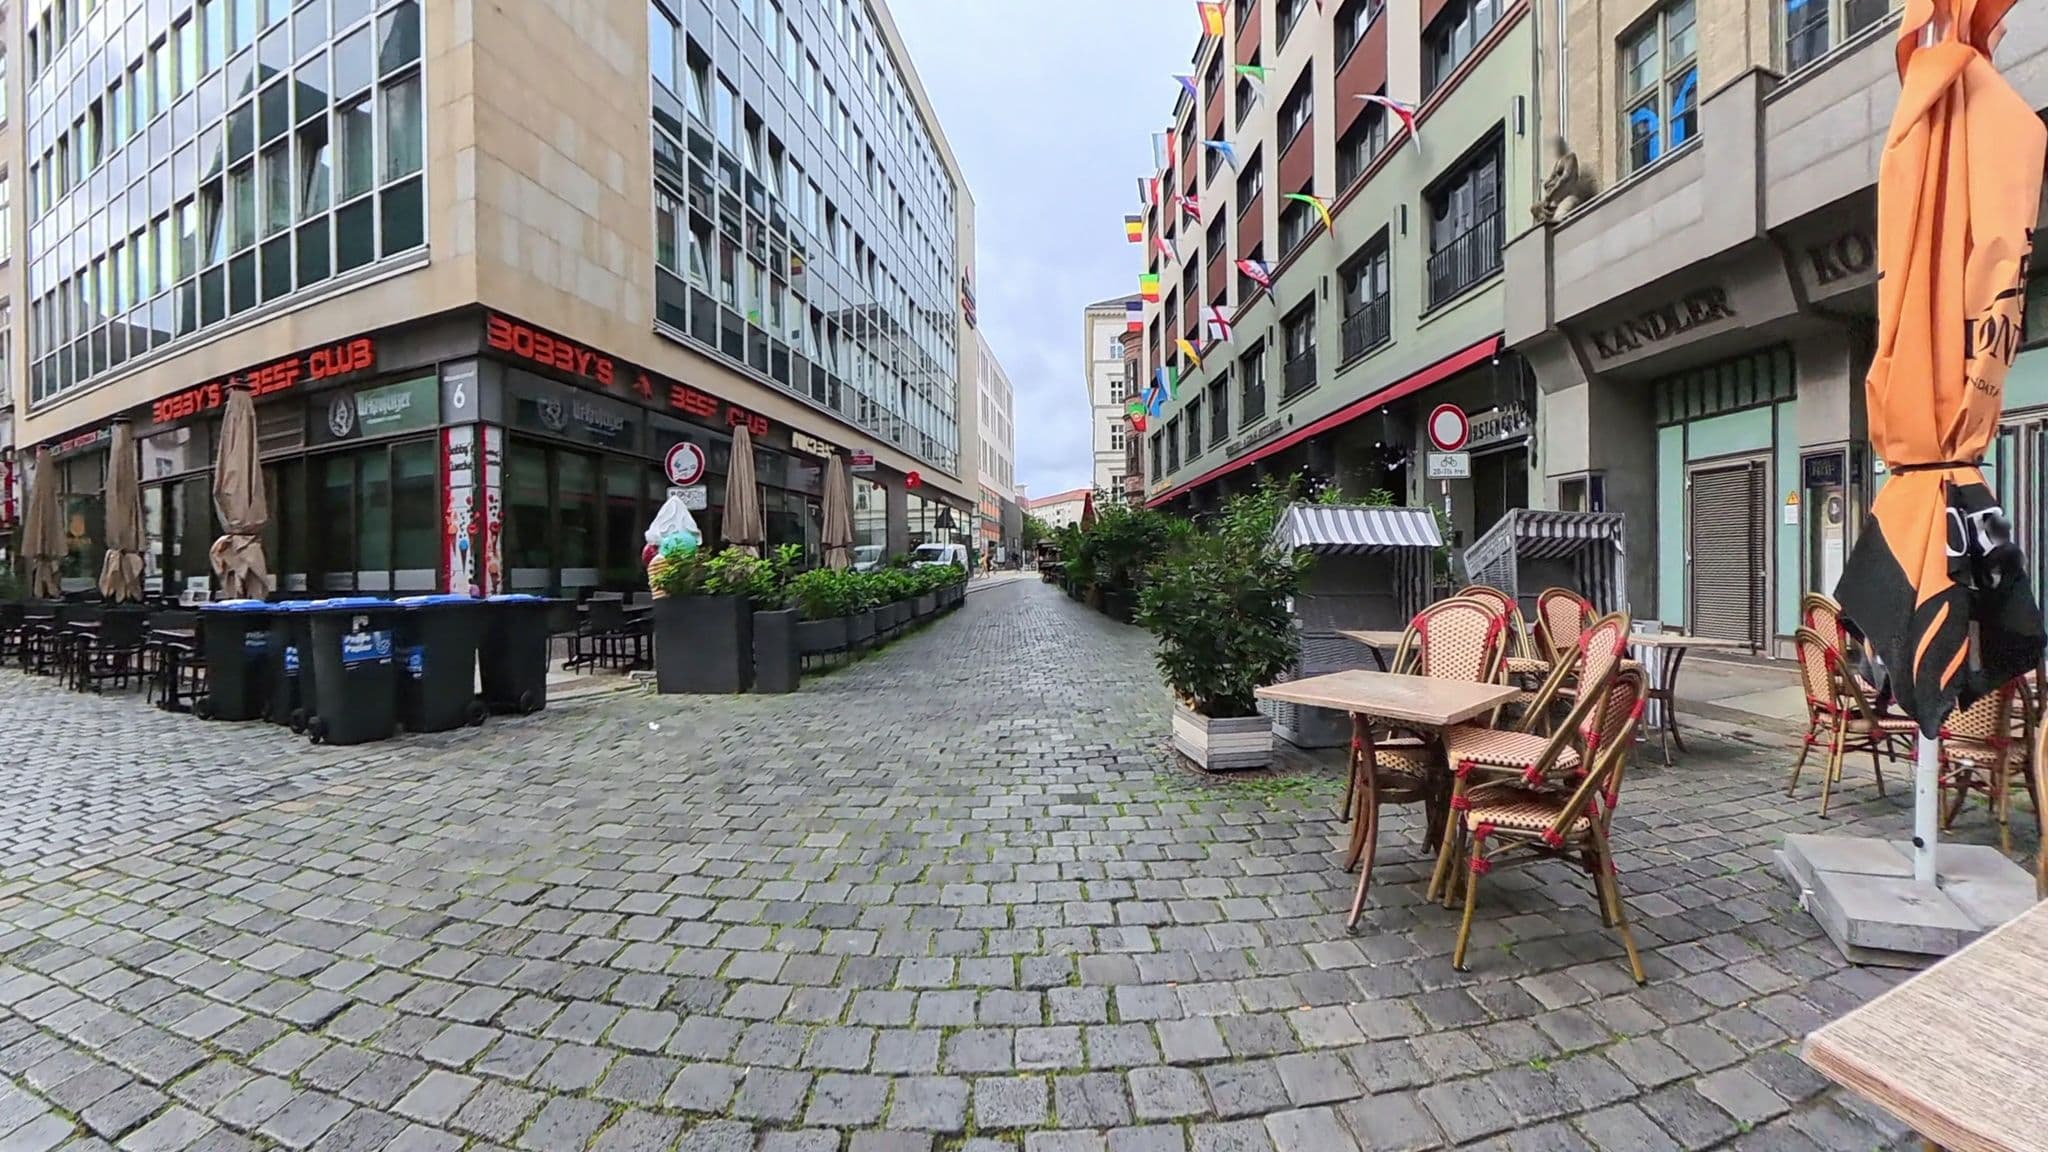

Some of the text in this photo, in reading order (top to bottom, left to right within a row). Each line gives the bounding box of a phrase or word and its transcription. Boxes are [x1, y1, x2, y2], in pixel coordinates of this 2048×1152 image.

[1596, 286, 1736, 359] KANDLER
[152, 338, 374, 424] BOBBY'S BEEF CLUB
[453, 383, 466, 409] 6
[487, 313, 616, 385] BOBBY'S
[670, 384, 719, 417] BEEF
